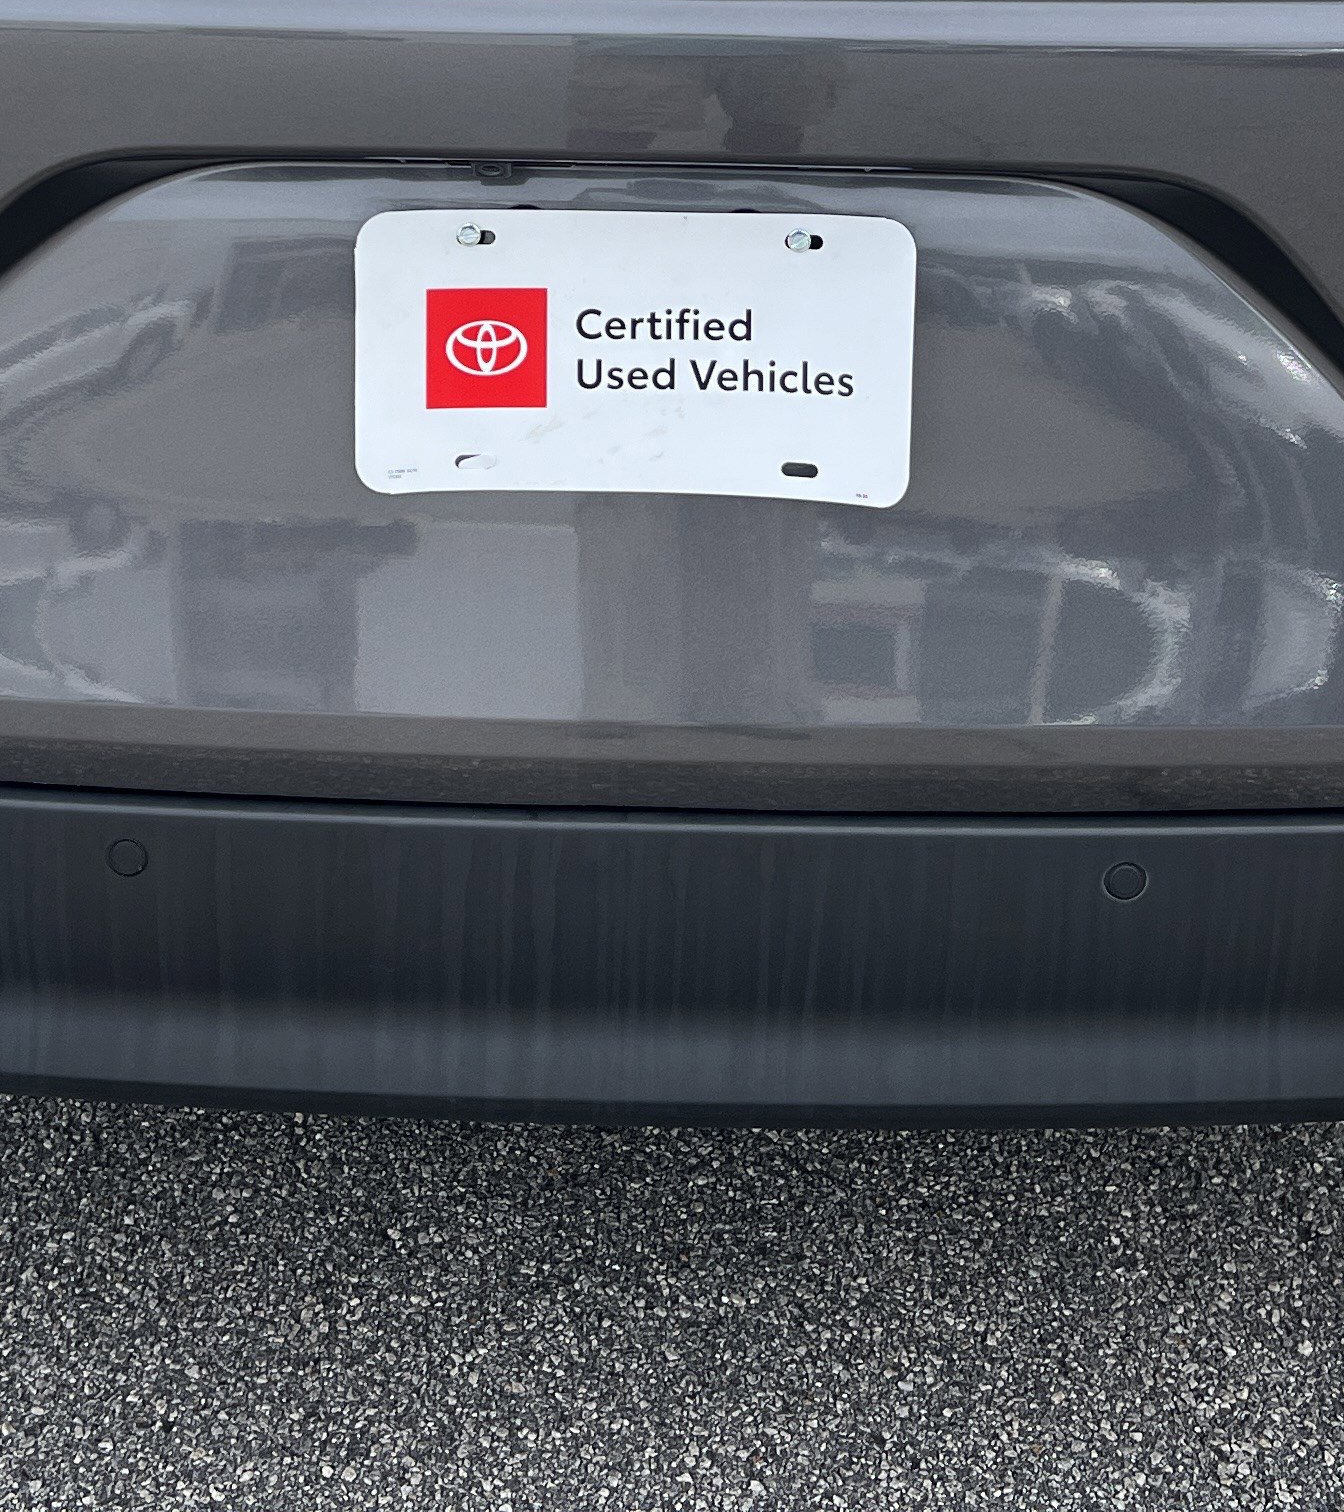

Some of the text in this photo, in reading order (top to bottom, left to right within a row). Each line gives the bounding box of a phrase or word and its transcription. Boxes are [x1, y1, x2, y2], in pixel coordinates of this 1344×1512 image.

[575, 309, 753, 342] Certified
[576, 358, 855, 397] Used Vehicles
